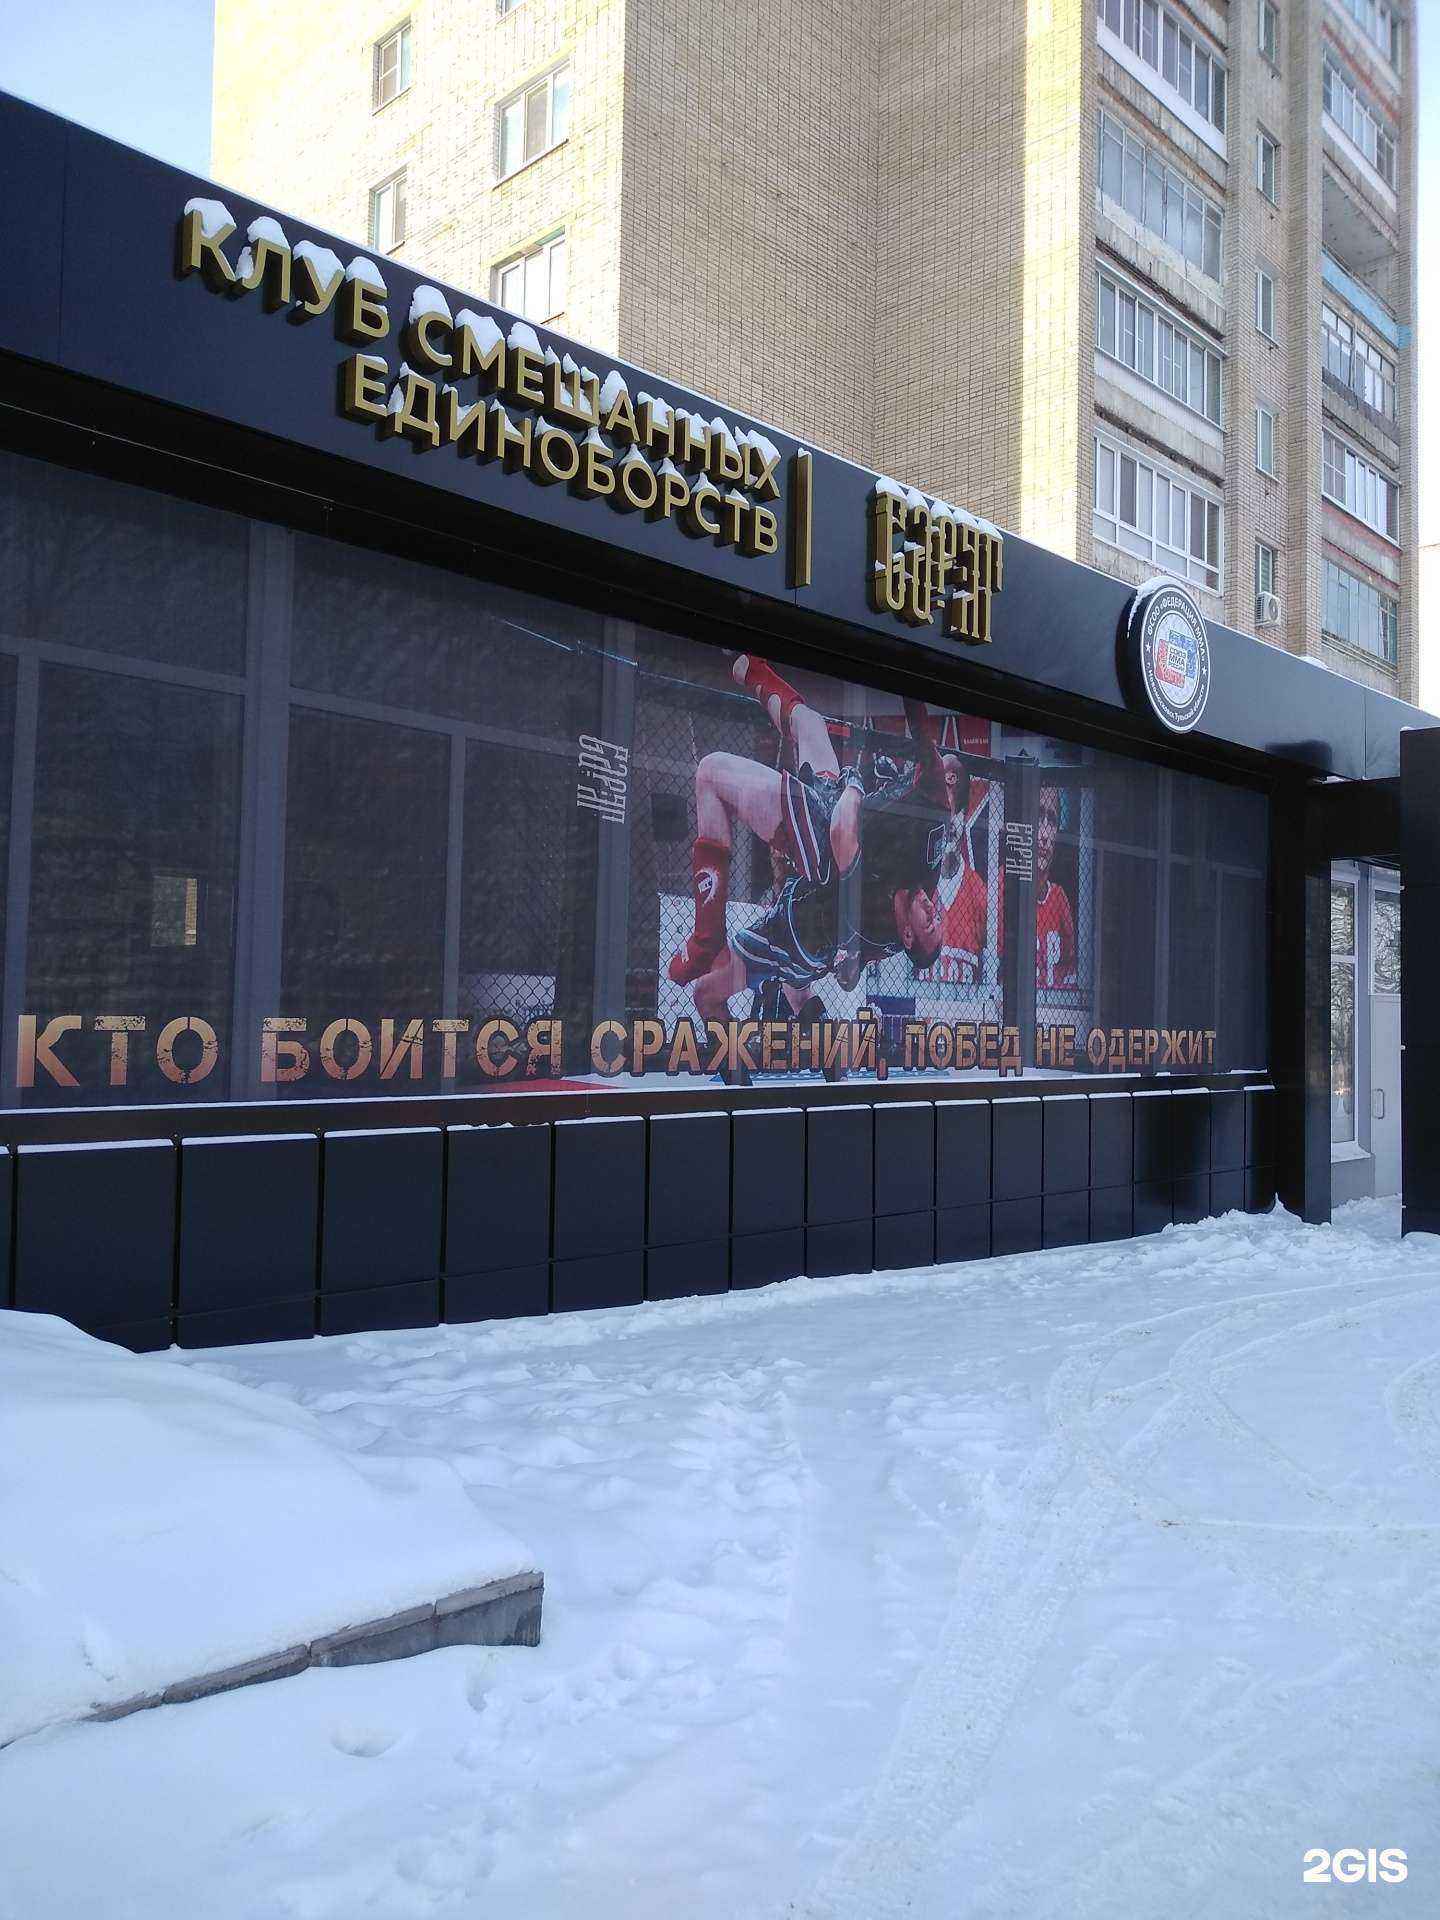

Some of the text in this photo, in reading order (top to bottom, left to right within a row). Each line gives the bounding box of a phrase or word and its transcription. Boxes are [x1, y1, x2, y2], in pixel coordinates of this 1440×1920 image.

[184, 207, 781, 499] КЛУБ СМЕШАННЫХ
[348, 353, 779, 555] ЕДИНОБОРСТВ
[16, 1009, 1217, 1088] КТО БОИТСЯ СРАЖЕНИЙ, ПОБЕД НЕ ОДЕРЖИТ
